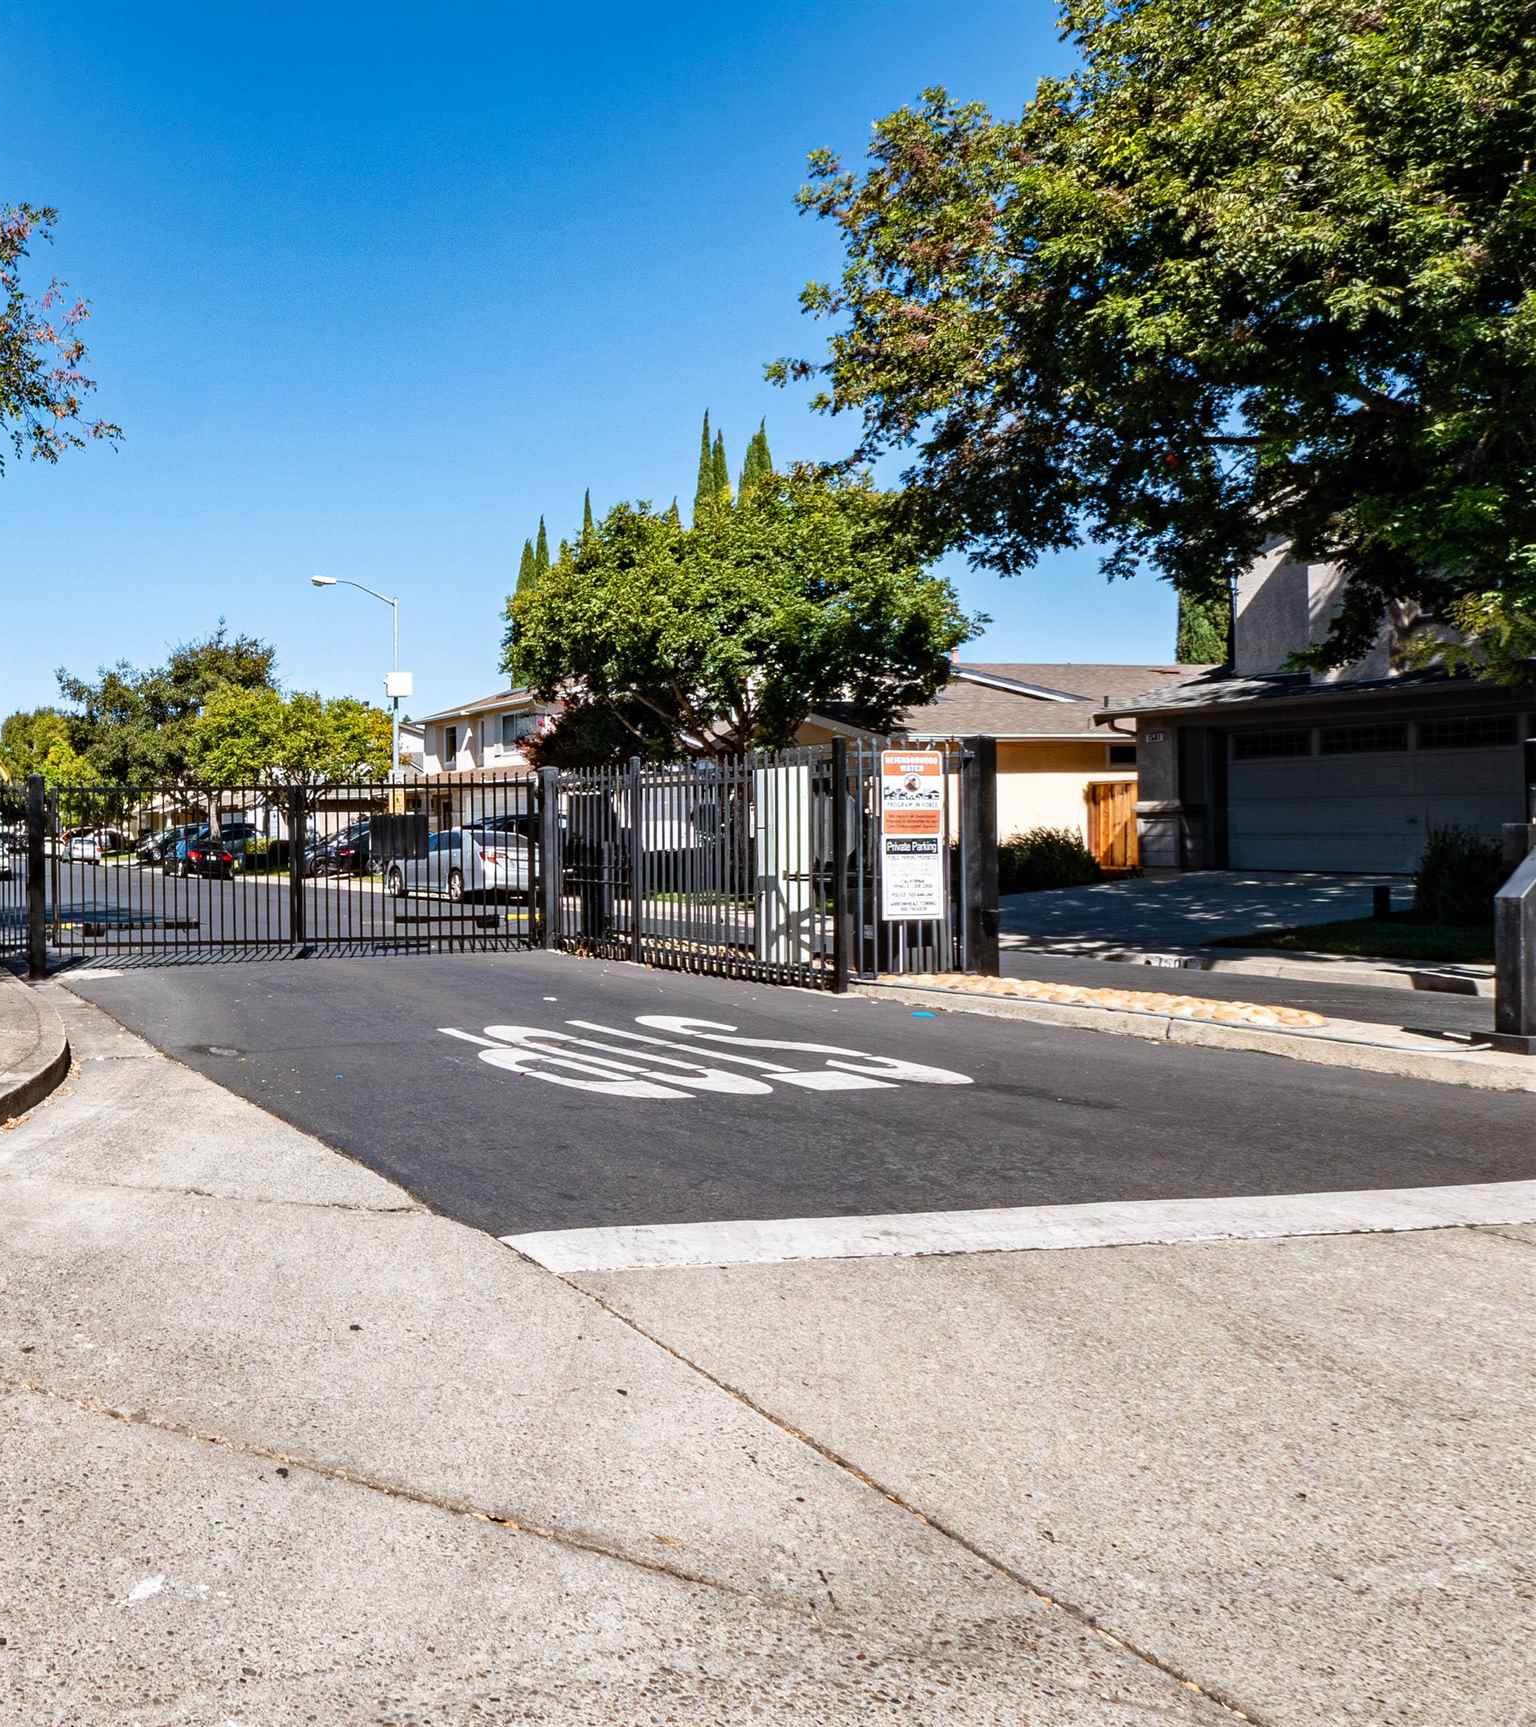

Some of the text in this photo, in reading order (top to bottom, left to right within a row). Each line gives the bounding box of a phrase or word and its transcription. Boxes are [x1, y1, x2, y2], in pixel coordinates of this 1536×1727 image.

[886, 840, 937, 853] Private Parking
[436, 1015, 977, 1099] STOP
